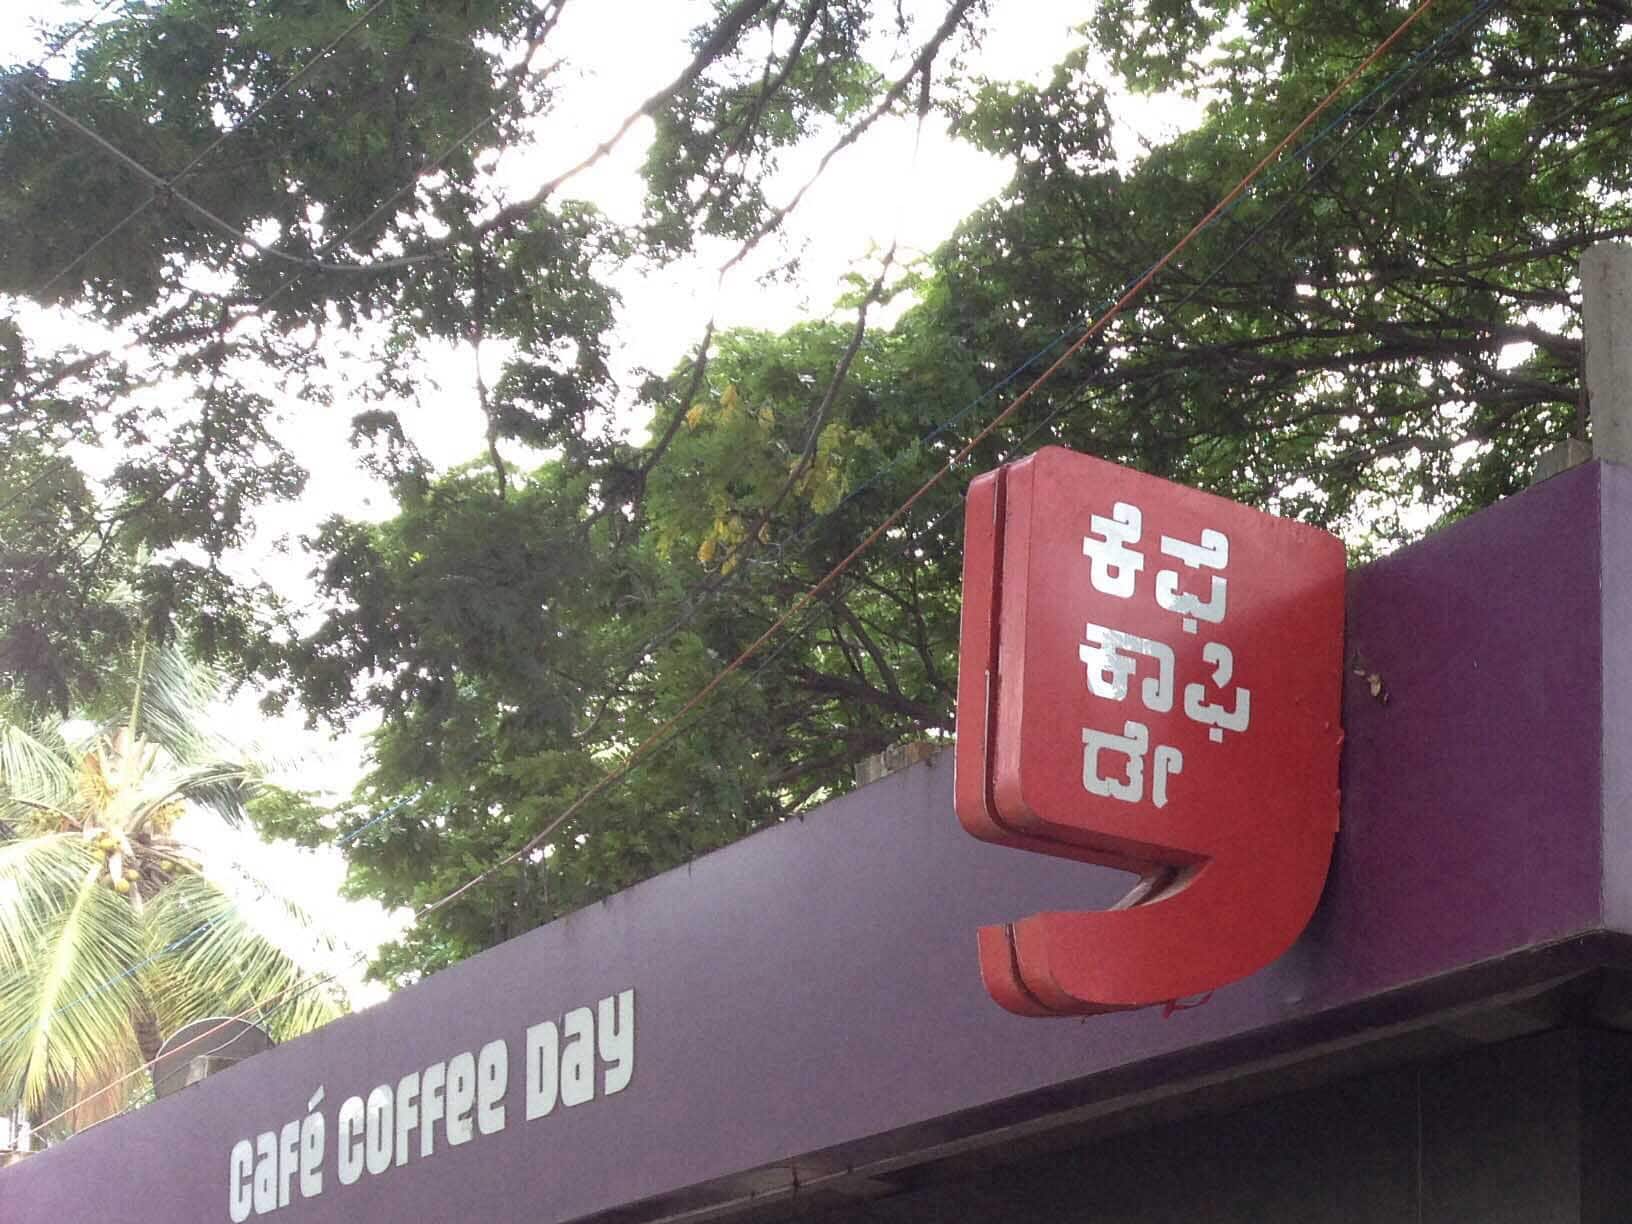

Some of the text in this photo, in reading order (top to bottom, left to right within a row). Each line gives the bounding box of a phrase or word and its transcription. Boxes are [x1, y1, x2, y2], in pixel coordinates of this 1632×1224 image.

[229, 988, 634, 1223] Café Coffee Day
